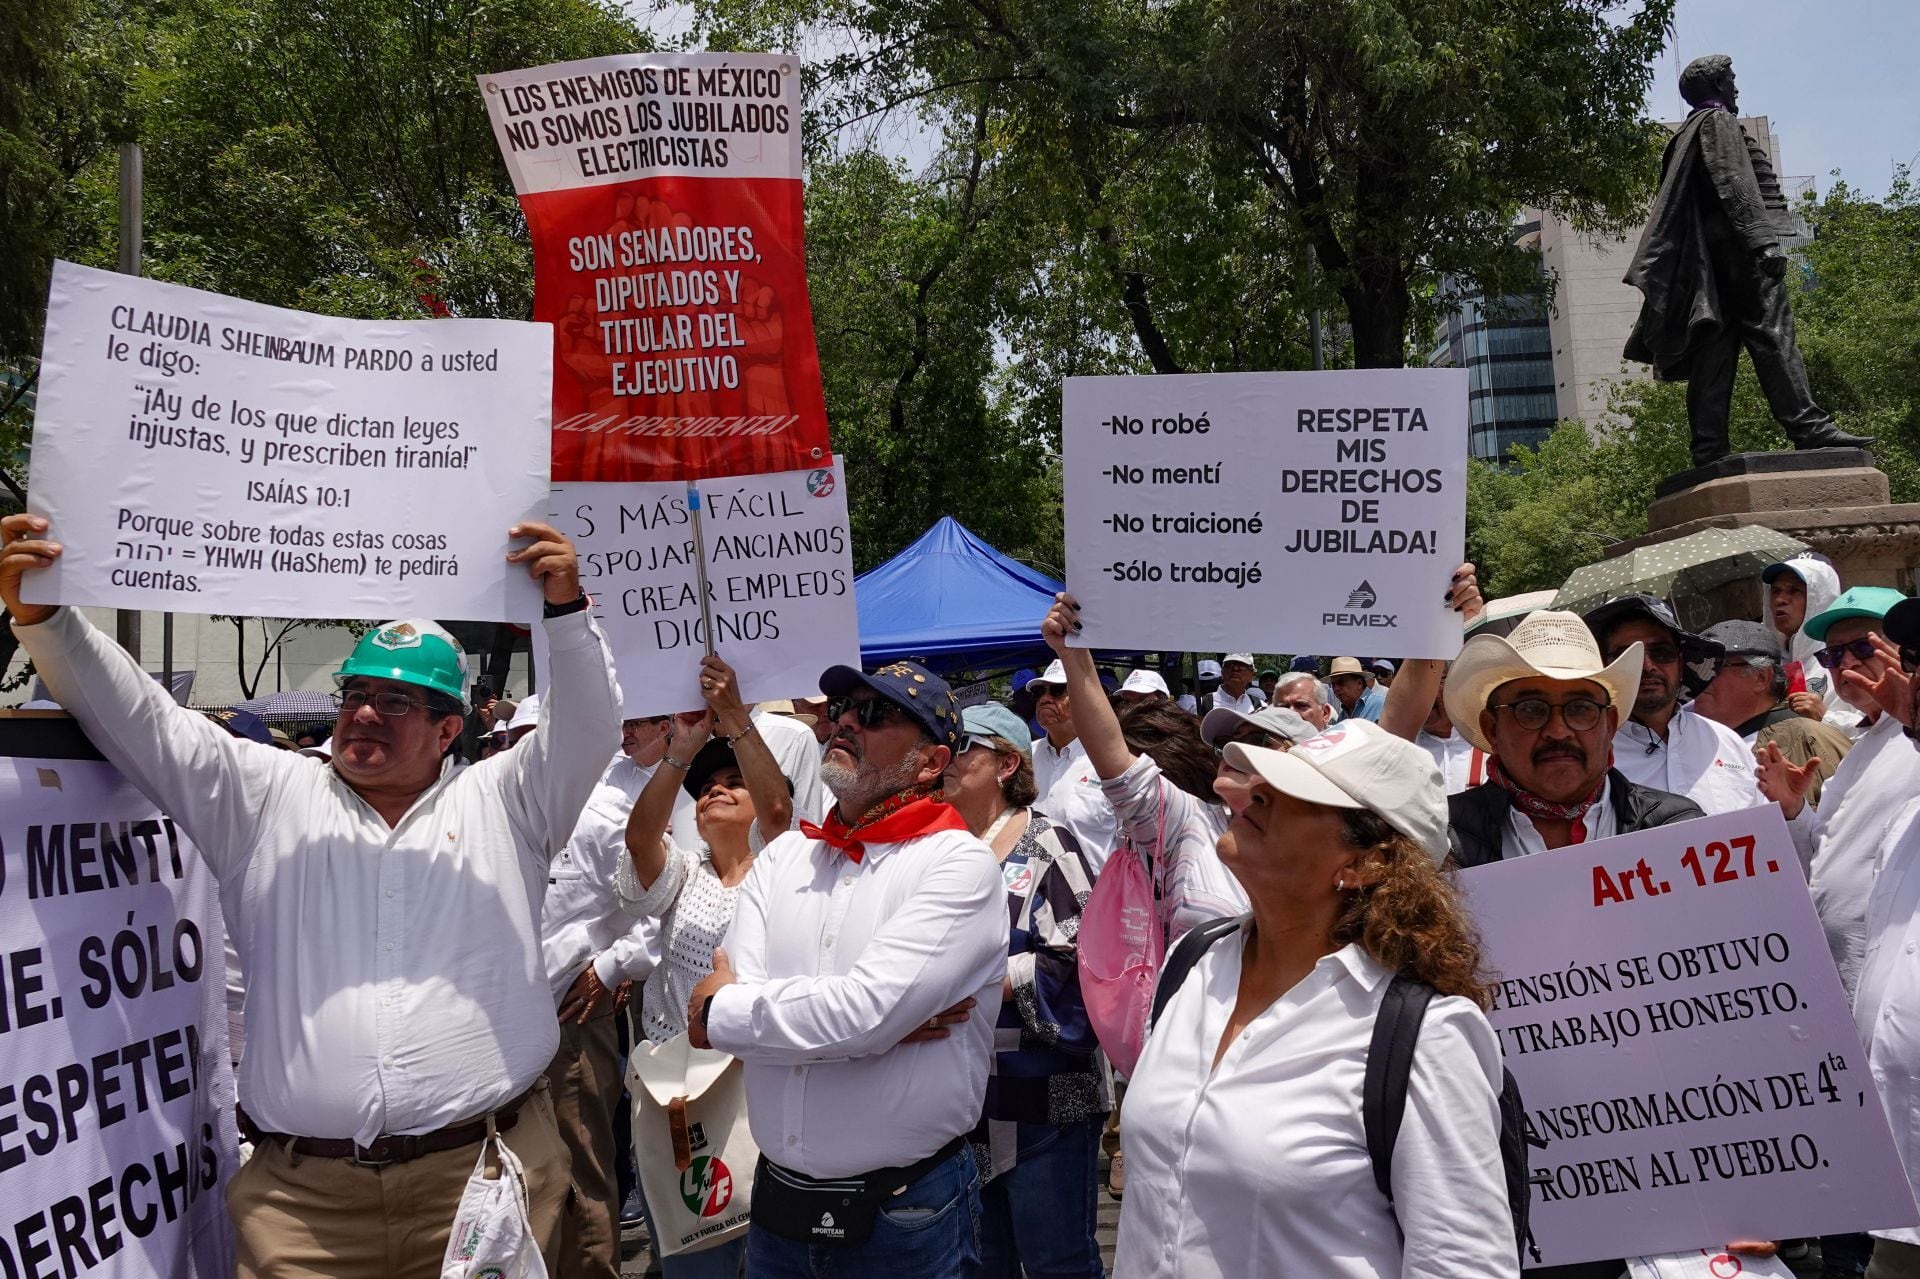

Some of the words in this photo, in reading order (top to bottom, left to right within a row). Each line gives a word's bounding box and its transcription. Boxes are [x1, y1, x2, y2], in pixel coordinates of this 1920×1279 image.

[501, 85, 546, 116] LOS
[546, 68, 657, 109] ENEMIGOS
[664, 67, 691, 96] DE
[698, 63, 781, 98] MÉXICO
[505, 120, 539, 152] NO
[543, 107, 622, 146] SOMOS
[624, 100, 662, 135] LOS
[669, 103, 789, 134] JUBILADOS
[577, 137, 728, 178] ELECTRICISTAS
[569, 234, 615, 272] SON
[620, 227, 762, 268] SENADORES,
[595, 271, 719, 312] DIPUTADOS
[724, 270, 740, 304] Y
[111, 305, 212, 348] CLAUDIA
[221, 327, 335, 368] SHEINBAUM
[345, 349, 413, 372] PARDO
[421, 353, 434, 372] a
[441, 348, 498, 372] usted
[600, 315, 694, 354] TITULAR
[700, 314, 746, 348] DEL
[106, 335, 130, 362] le
[140, 343, 200, 377] digo:
[612, 355, 739, 396] EJECUTIVO
[192, 394, 221, 420] de
[231, 400, 266, 428] los
[275, 410, 317, 437] que
[326, 413, 395, 439] dictan
[403, 416, 459, 445] leyes
[606, 414, 799, 437] PRESIDENTA)
[1101, 415, 1143, 435] -No
[1152, 412, 1210, 435] robé
[1297, 408, 1428, 433] RESPETA
[129, 415, 231, 457] injustas,
[240, 439, 255, 465] y
[264, 440, 386, 467] prescriben
[1336, 439, 1386, 462] MIS
[247, 477, 308, 506] ISAÍAS
[315, 484, 351, 508] 10:1
[1102, 465, 1144, 484] -No
[1152, 462, 1223, 484] mentí
[1281, 469, 1442, 493] DERECHOS
[118, 508, 194, 543] Porque
[202, 522, 262, 543] sobre
[269, 525, 325, 549] todas
[332, 530, 384, 550] estas
[391, 531, 447, 550] cosas
[620, 494, 689, 534] MÁS
[707, 488, 804, 520] FÁCIL
[1103, 513, 1145, 534] -No
[1152, 512, 1263, 534] traicioné
[1341, 499, 1378, 523] DE
[204, 544, 263, 571] YHWH
[271, 549, 367, 577] (HaShem)
[375, 552, 393, 574] te
[399, 555, 459, 580] pedirá
[578, 541, 697, 577] SPOJAR
[712, 526, 845, 562] ANCIANOS
[1284, 530, 1437, 555] JUBILADA!
[111, 568, 202, 594] cuentas.
[727, 570, 846, 602] EMPLEOS
[1103, 560, 1163, 583] -Sólo
[1170, 561, 1262, 589] trabajé
[1322, 613, 1398, 627] PEMEX
[1592, 857, 1672, 907] Art.
[1680, 834, 1779, 887] 127.
[79, 911, 203, 1009] SÓLO
[1489, 960, 1612, 1011] PENSIÓN
[1616, 957, 1654, 989] SE
[1657, 932, 1790, 982] OBTUVO
[1509, 1008, 1641, 1055] TRABAJO
[1644, 982, 1808, 1033] HONESTO.
[1765, 1071, 1814, 1110] DE
[1532, 1155, 1640, 1201] ROBEN
[1650, 1148, 1690, 1188] AL
[1690, 1133, 1829, 1182] PUEBLO.
[681, 1236, 694, 1245] LUZ
[700, 1222, 725, 1236] FUERZA
[726, 1216, 738, 1227] DEL
